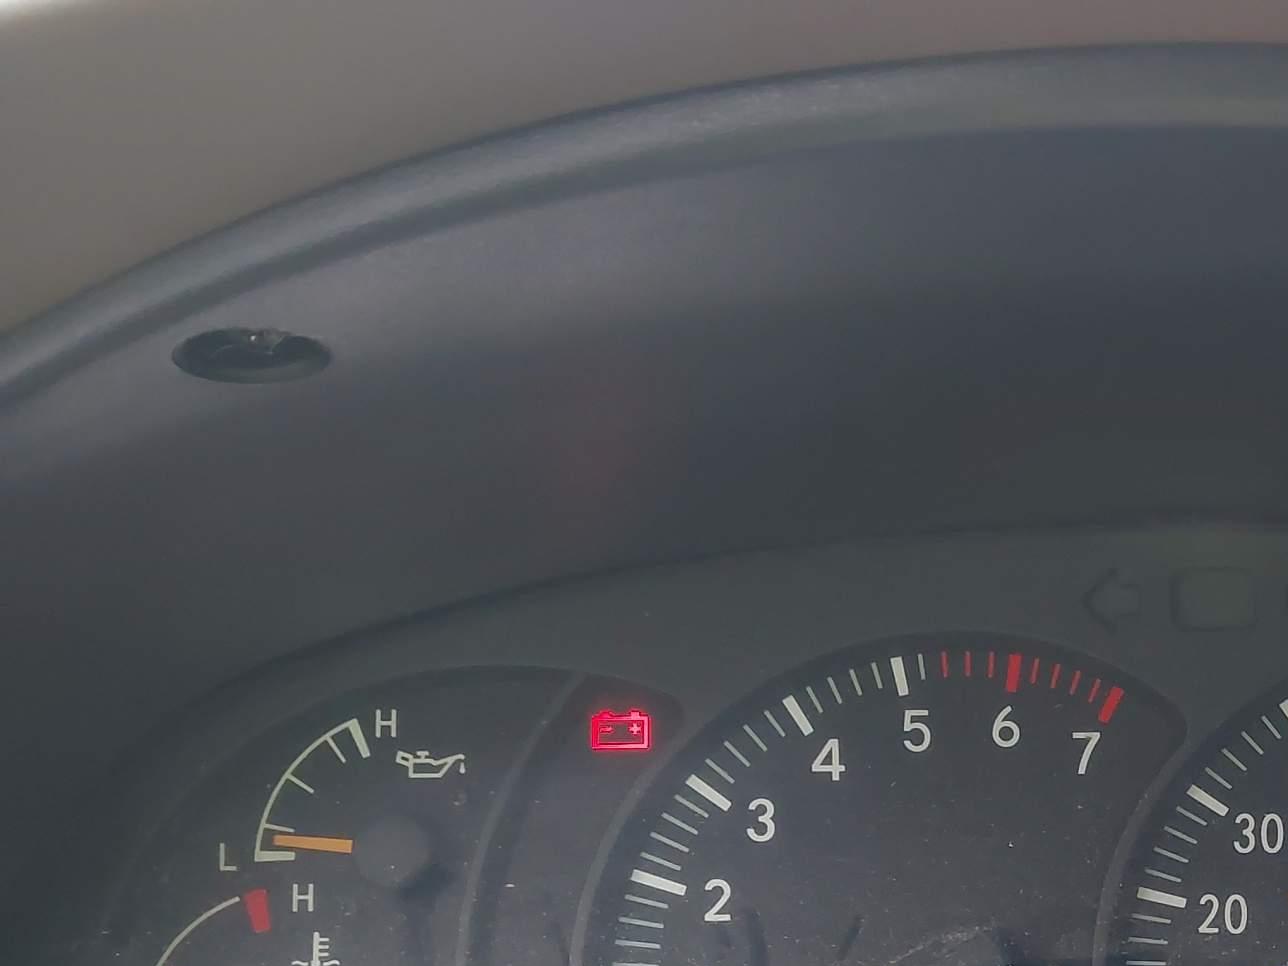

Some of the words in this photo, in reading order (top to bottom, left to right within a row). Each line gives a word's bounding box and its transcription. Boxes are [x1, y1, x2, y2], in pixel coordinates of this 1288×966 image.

[375, 709, 397, 738] H
[903, 709, 931, 752] 5
[992, 706, 1020, 748] 6
[811, 738, 846, 781] 4
[1072, 732, 1100, 774] 7
[746, 799, 775, 842] 3
[1233, 813, 1285, 854] 30
[219, 843, 238, 871] L
[292, 883, 314, 912] H
[703, 879, 732, 922] 2
[1198, 894, 1248, 935] 20
